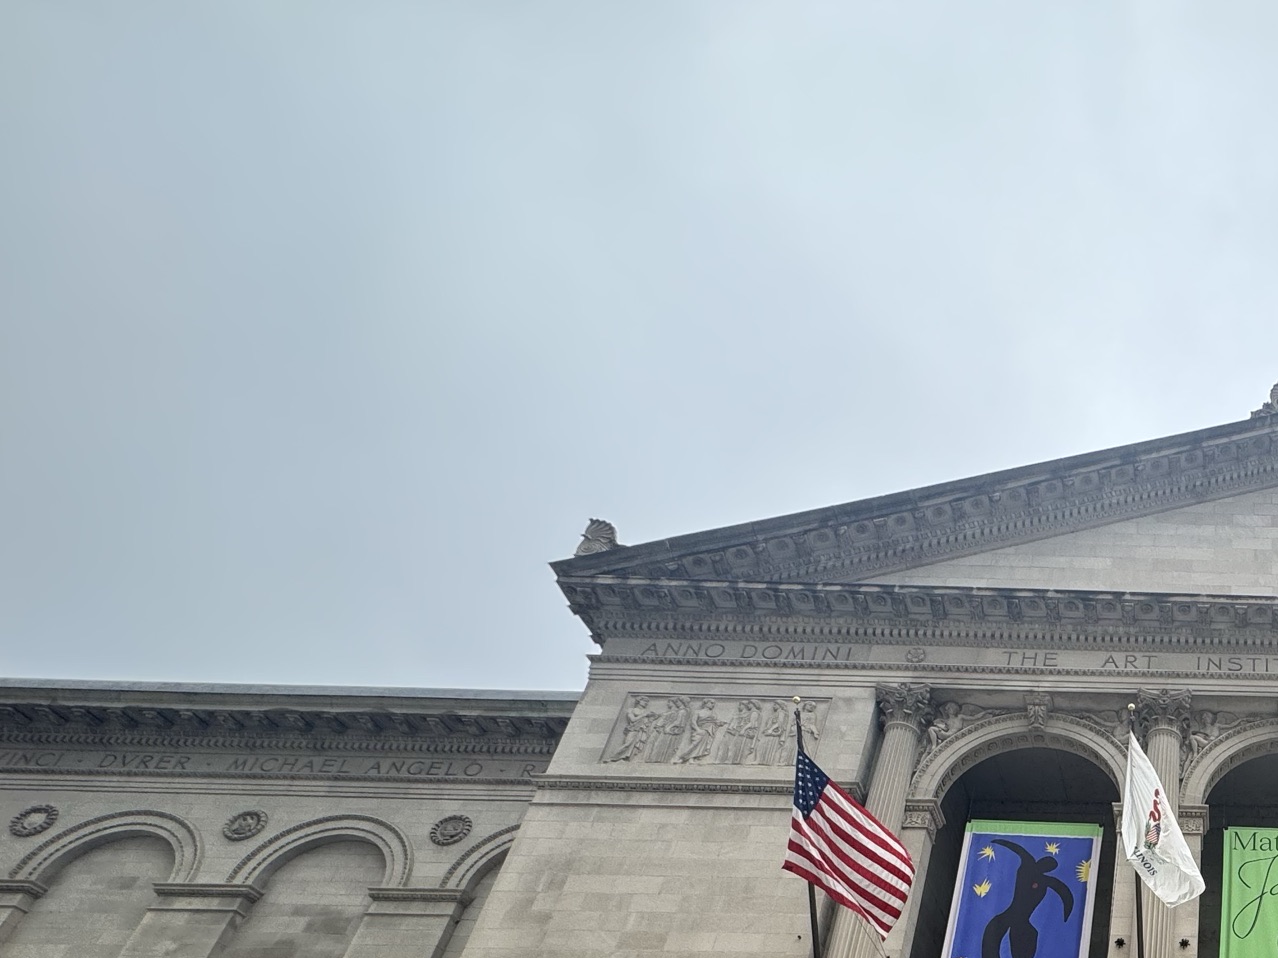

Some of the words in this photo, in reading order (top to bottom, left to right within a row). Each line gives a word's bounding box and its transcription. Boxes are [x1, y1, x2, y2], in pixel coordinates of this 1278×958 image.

[641, 642, 726, 659] ANNO
[739, 644, 853, 662] DOMINI
[1002, 651, 1059, 667] THE
[1100, 654, 1158, 670] ART
[97, 753, 191, 771] DVRER
[226, 757, 350, 774] MICHAEL
[363, 760, 484, 777] ANGELO
[1132, 845, 1158, 876] LINOIS
